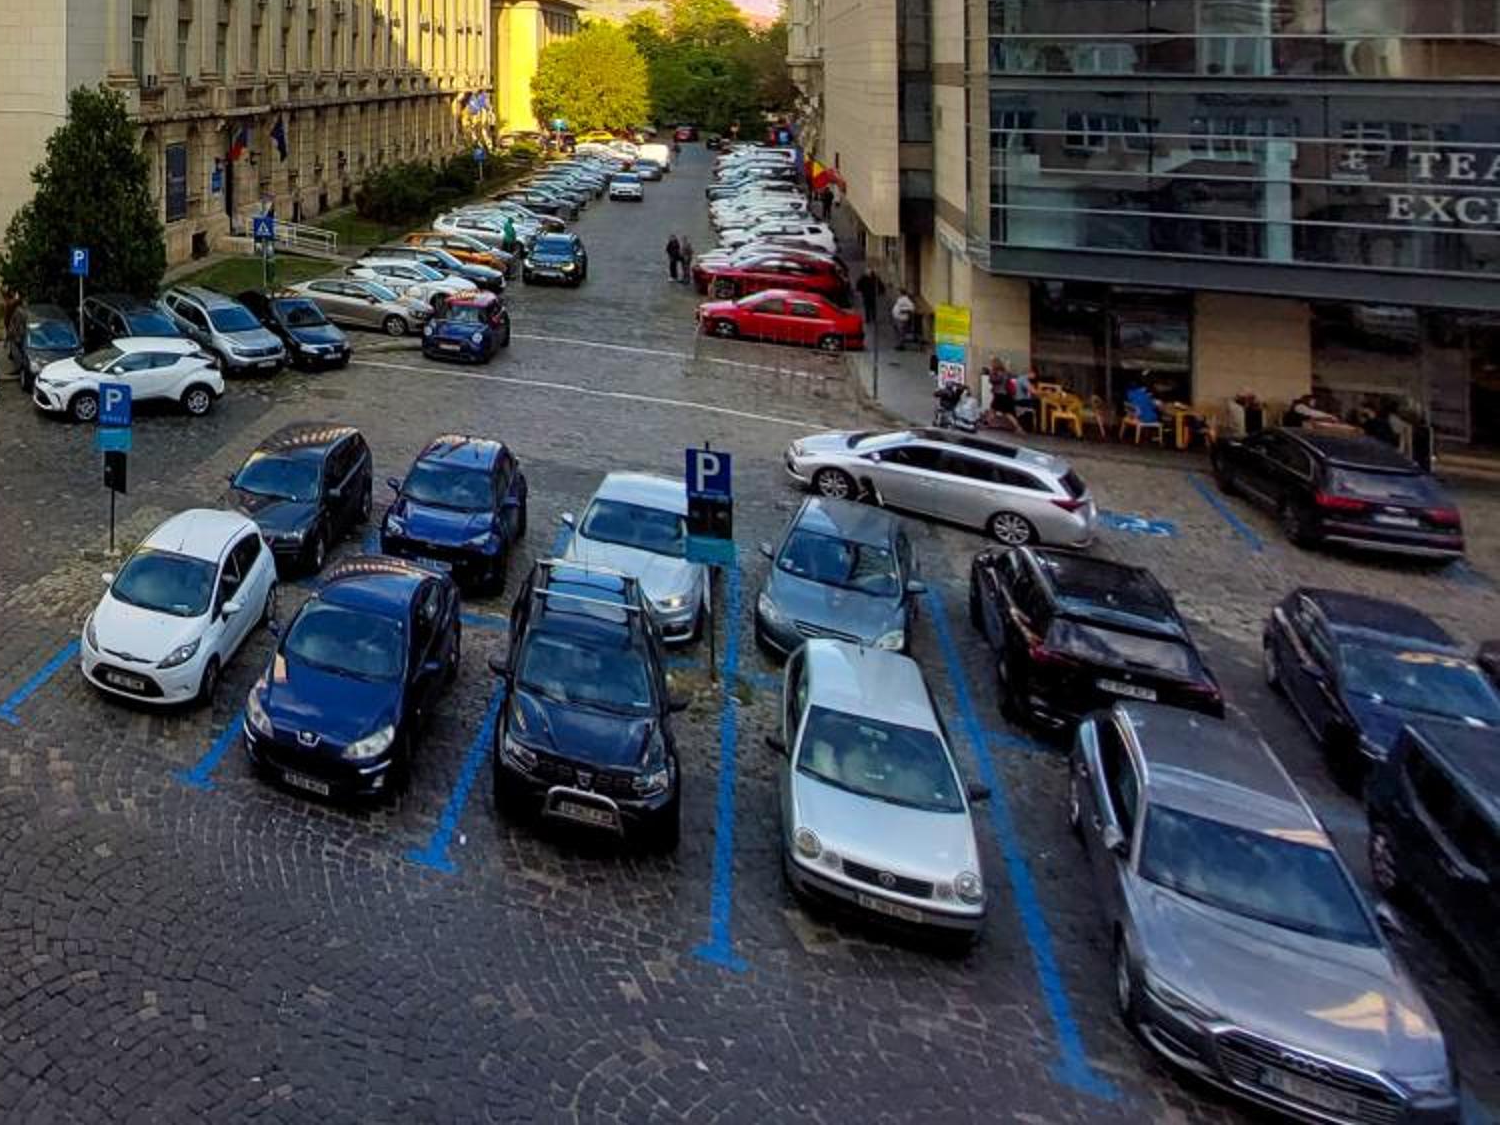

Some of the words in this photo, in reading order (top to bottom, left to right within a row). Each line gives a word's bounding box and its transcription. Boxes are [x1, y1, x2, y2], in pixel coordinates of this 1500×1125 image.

[74, 250, 84, 268] P
[105, 388, 122, 412] P
[696, 453, 720, 492] P
